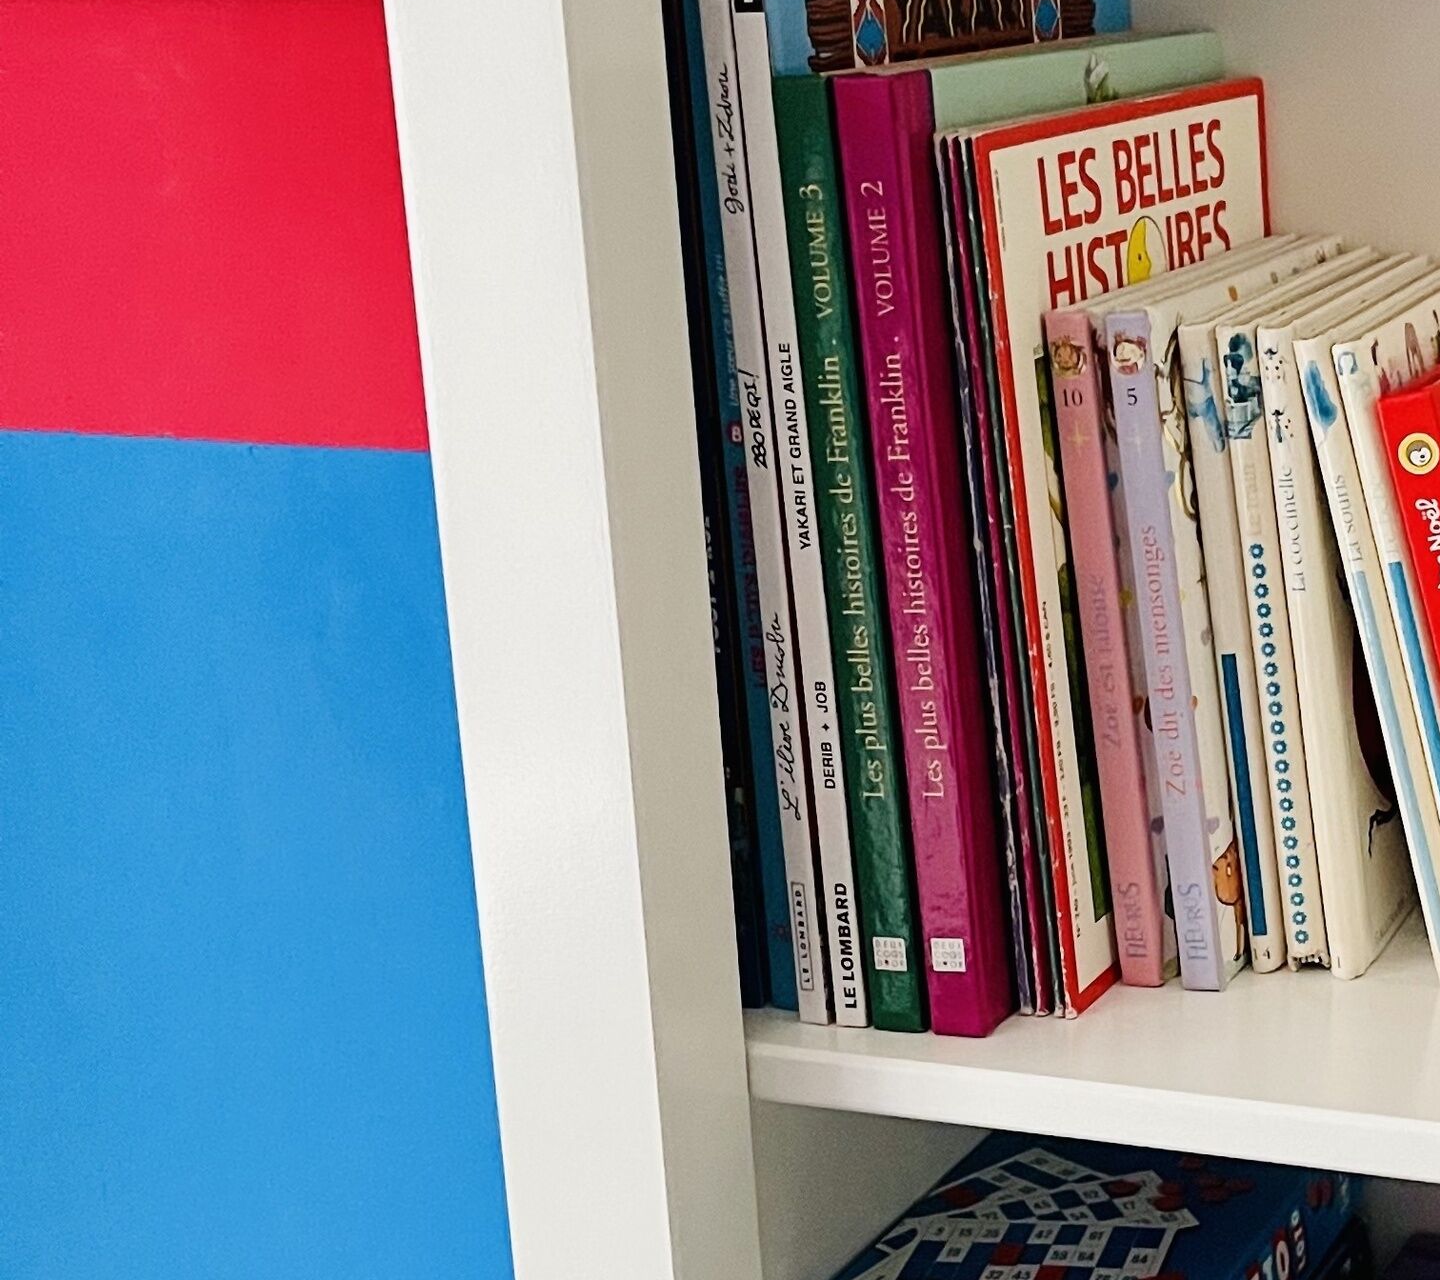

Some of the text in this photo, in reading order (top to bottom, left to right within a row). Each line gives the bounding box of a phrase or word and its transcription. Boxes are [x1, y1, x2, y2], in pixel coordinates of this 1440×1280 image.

[1036, 118, 1226, 236] LES BELLES
[799, 183, 835, 320] VOLUME 3
[860, 180, 896, 317] VOLUME 2
[779, 342, 811, 551] YAKARI ET GRAND AIGLE
[1062, 388, 1084, 408] 10
[1126, 386, 1139, 407] 5
[1278, 465, 1303, 566] coccinelle
[1335, 474, 1355, 534] souris
[817, 355, 887, 800] Les plus belles histoires de Franklin
[880, 353, 949, 800] Les plus belles histoires de Franklin
[1141, 523, 1171, 657] mensonges
[814, 680, 836, 790] DERIB JOB
[1154, 670, 1176, 704] des
[835, 882, 857, 1009] LE LOMBARD
